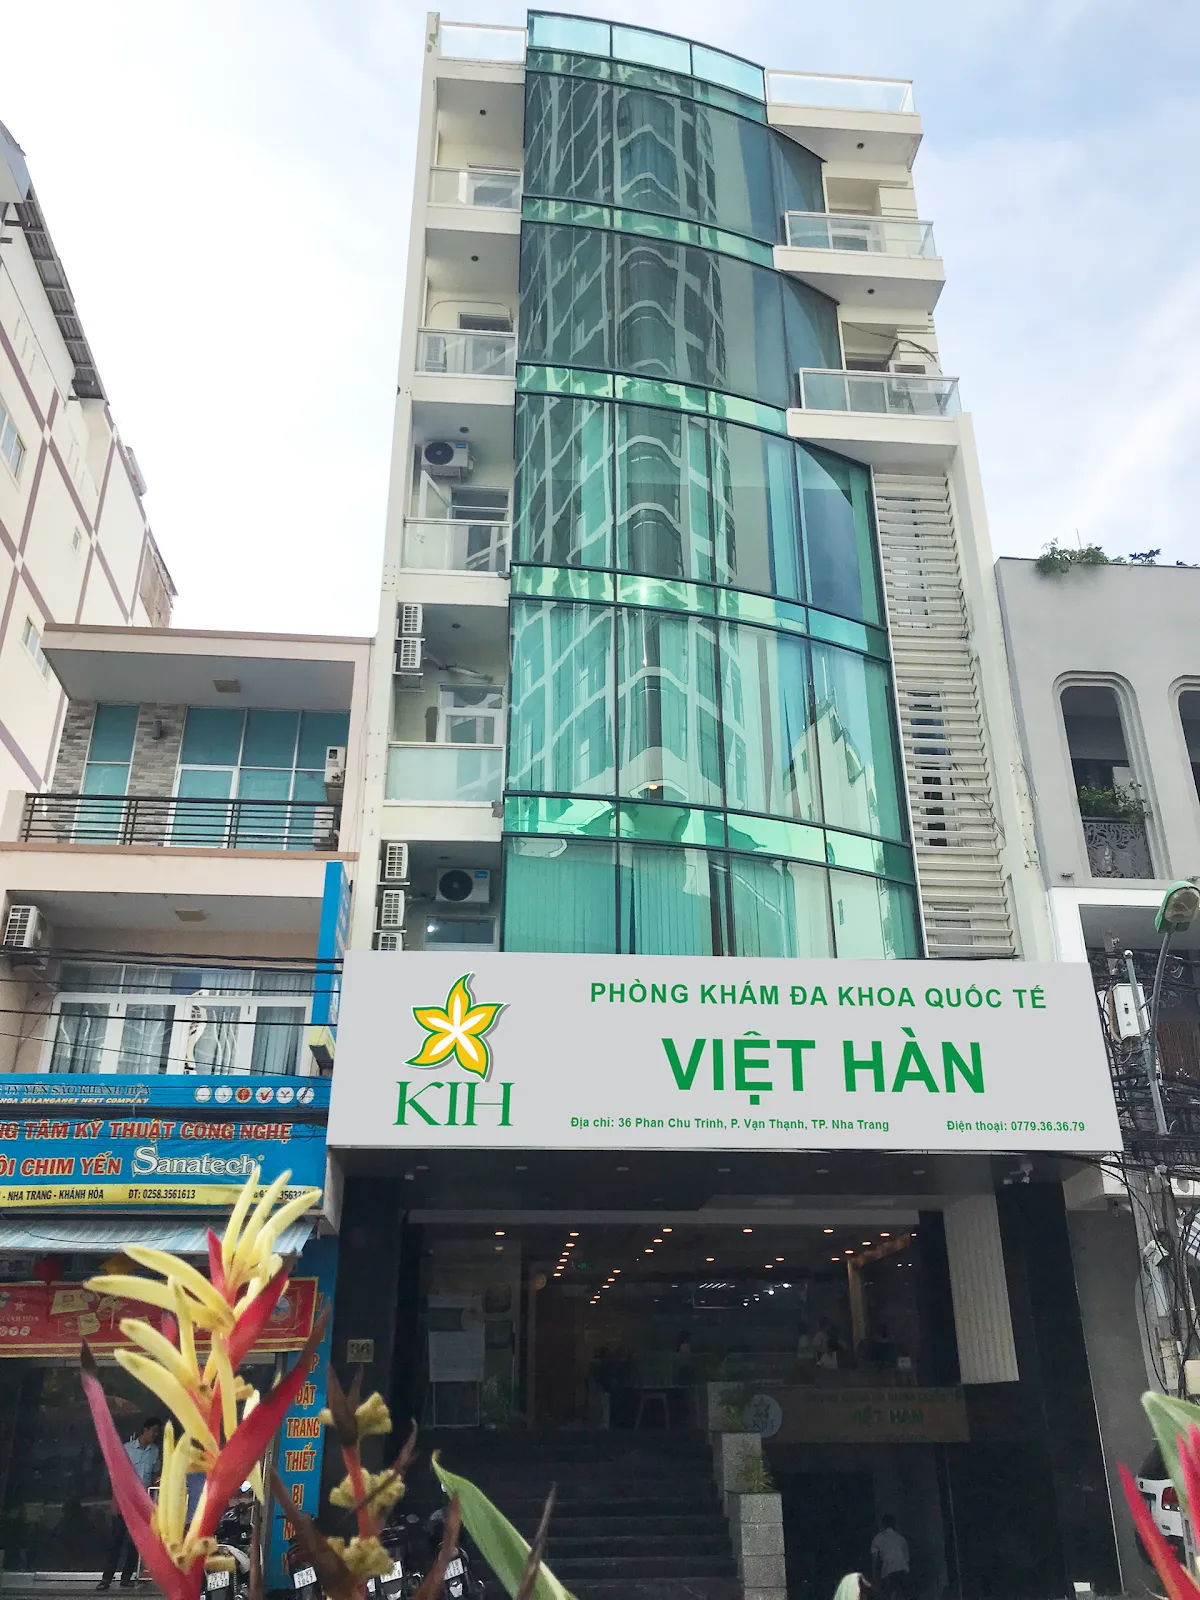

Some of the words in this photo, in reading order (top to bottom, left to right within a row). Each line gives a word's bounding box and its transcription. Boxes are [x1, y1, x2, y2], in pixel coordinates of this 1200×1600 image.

[590, 978, 689, 1004] PHÒNG
[700, 980, 779, 1005] KHÁM
[789, 985, 828, 1006] ĐA
[838, 986, 916, 1007] KHOA
[924, 983, 1002, 1008] QUỐC
[1012, 984, 1047, 1009] TẾ
[660, 1030, 816, 1106] VIỆT
[842, 1026, 985, 1094] HÀN
[392, 1081, 515, 1127] KIH
[24, 1119, 69, 1140] TÂM
[110, 1118, 174, 1143] THUẬT
[570, 1116, 590, 1130] Địa
[618, 1117, 632, 1128] 36
[635, 1117, 664, 1128] Phan
[668, 1117, 691, 1128] Chu
[731, 1118, 741, 1129] P.
[744, 1118, 766, 1131] Vạn
[769, 1119, 808, 1131] Thạnh,
[811, 1119, 829, 1129] TP.
[832, 1119, 854, 1129] Nha
[857, 1119, 889, 1132] Trang
[946, 1119, 973, 1132] Điện
[975, 1120, 1007, 1132] thoại:
[1010, 1120, 1085, 1131] 0779.36.36.79
[20, 1156, 75, 1176] CHIM
[80, 1151, 122, 1176] YẾN
[131, 1144, 258, 1177] Sanatech
[7, 1190, 24, 1200] NHA
[26, 1190, 52, 1200] TRANG
[58, 1188, 86, 1200] KHÁNH
[286, 1417, 321, 1439] TRANG
[285, 1441, 317, 1473] THIẾT
[292, 1483, 305, 1510] BỊ
